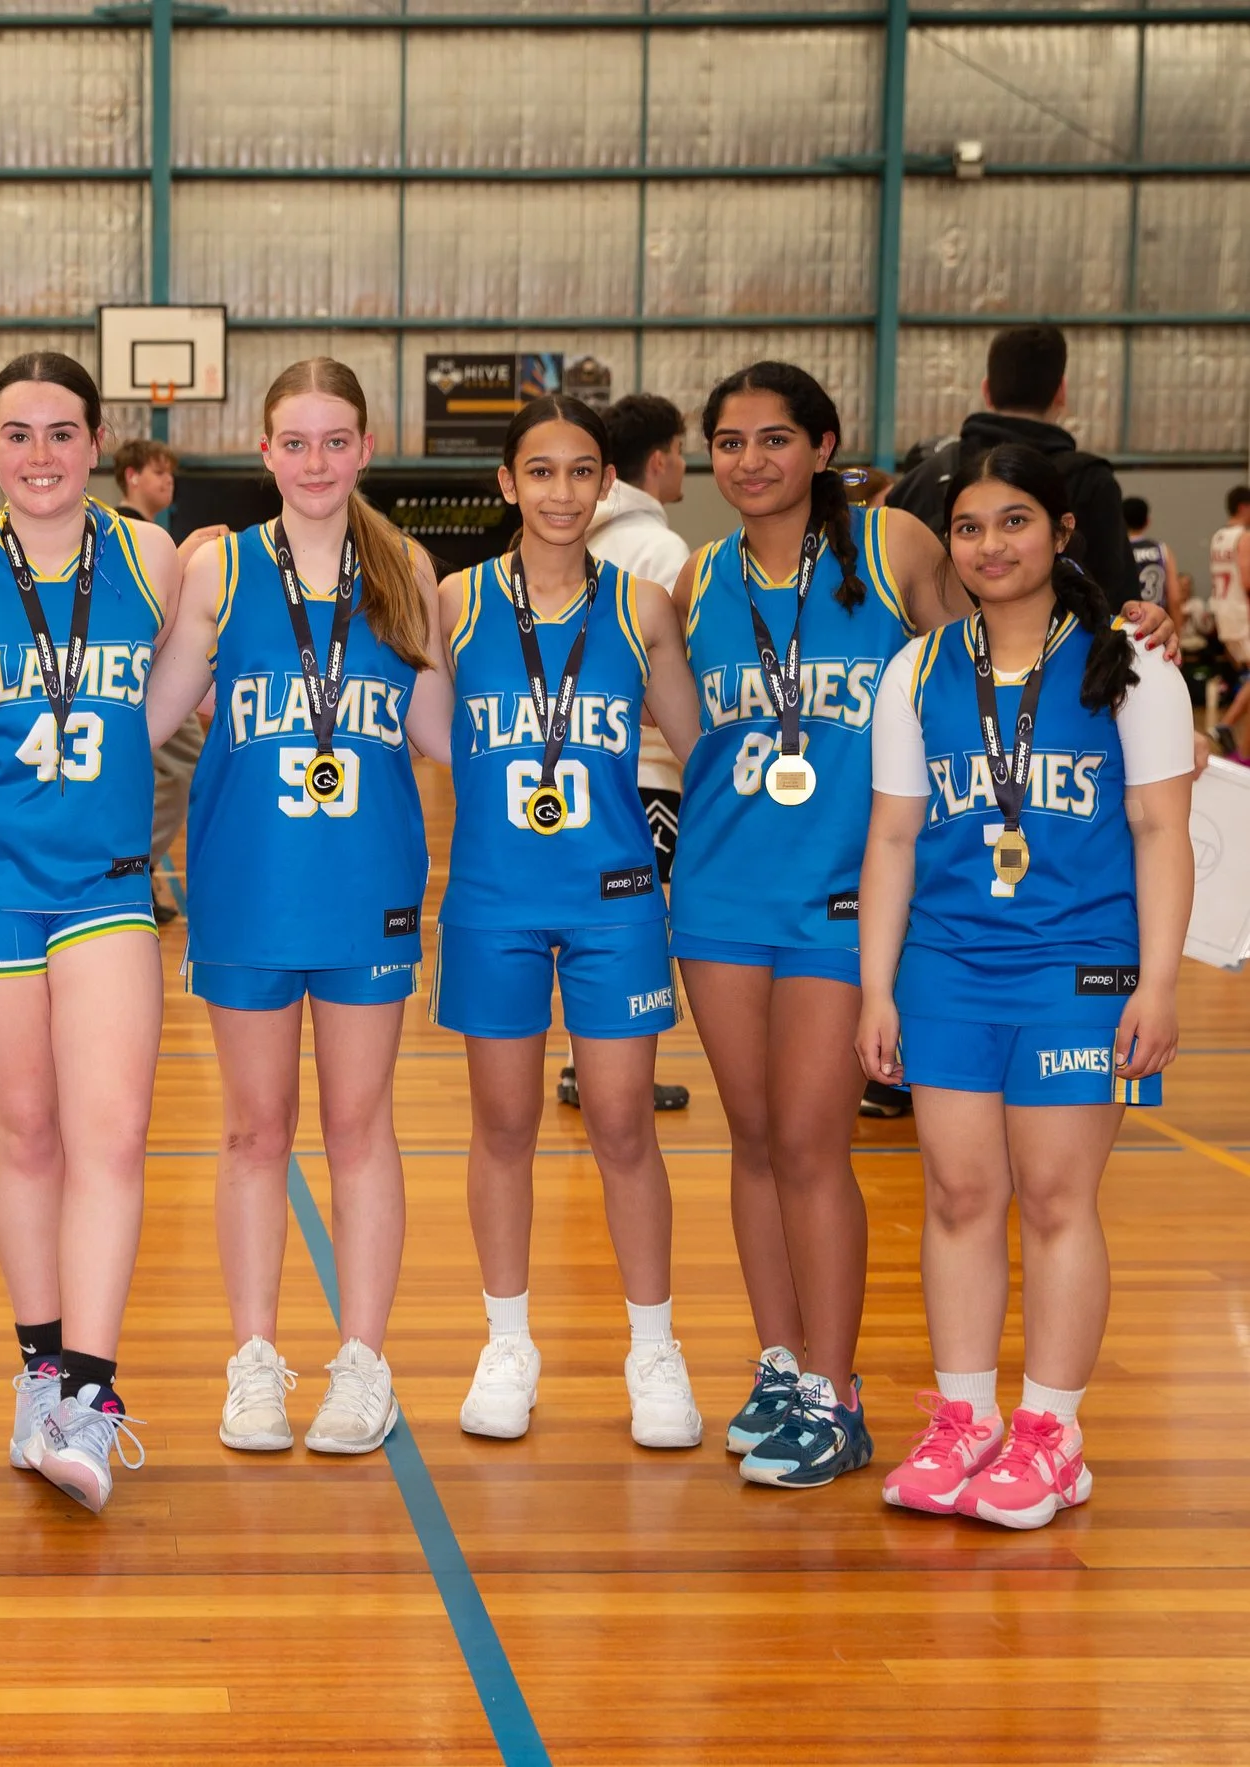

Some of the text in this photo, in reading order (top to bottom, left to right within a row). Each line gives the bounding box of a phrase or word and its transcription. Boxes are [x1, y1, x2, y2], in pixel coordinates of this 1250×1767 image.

[464, 364, 510, 380] HIVE
[6, 534, 22, 568] PACERS
[84, 534, 93, 571] PACERS
[284, 569, 298, 605] PACERS
[513, 573, 525, 609] PACERS
[38, 632, 53, 672] PACERS
[70, 636, 82, 678] PACERS
[330, 640, 341, 681] PACERS
[789, 639, 797, 680] PACERS
[231, 677, 403, 745] FLAMES
[309, 676, 321, 715] PACERS
[534, 676, 545, 716] PACERS
[560, 675, 572, 716] PACERS
[15, 712, 103, 781] 43
[985, 716, 1000, 757] PACERS
[278, 747, 360, 817] 50
[1015, 741, 1026, 785] PACERS
[506, 759, 590, 829] 60
[1123, 975, 1137, 986] XS
[629, 986, 672, 1018] FLAMES
[1038, 1049, 1109, 1077] FLAMES
